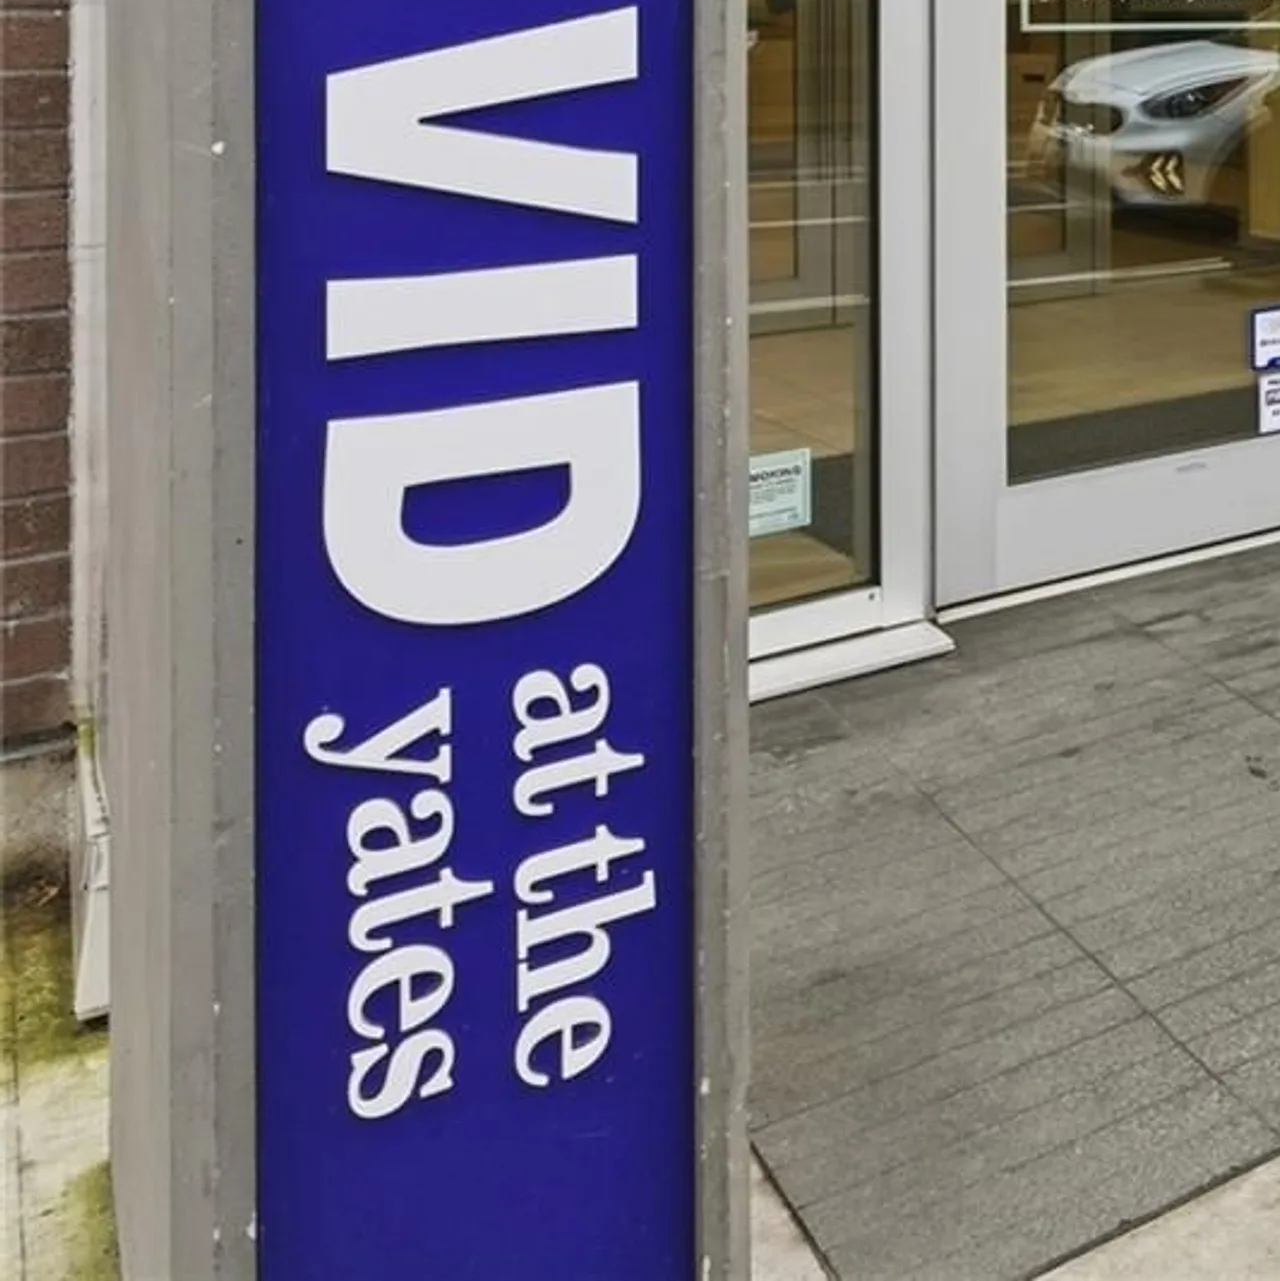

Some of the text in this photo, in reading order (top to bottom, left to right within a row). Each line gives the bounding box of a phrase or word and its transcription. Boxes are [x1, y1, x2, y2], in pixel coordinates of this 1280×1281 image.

[303, 687, 494, 1120] yates
[513, 663, 656, 1087] at the
